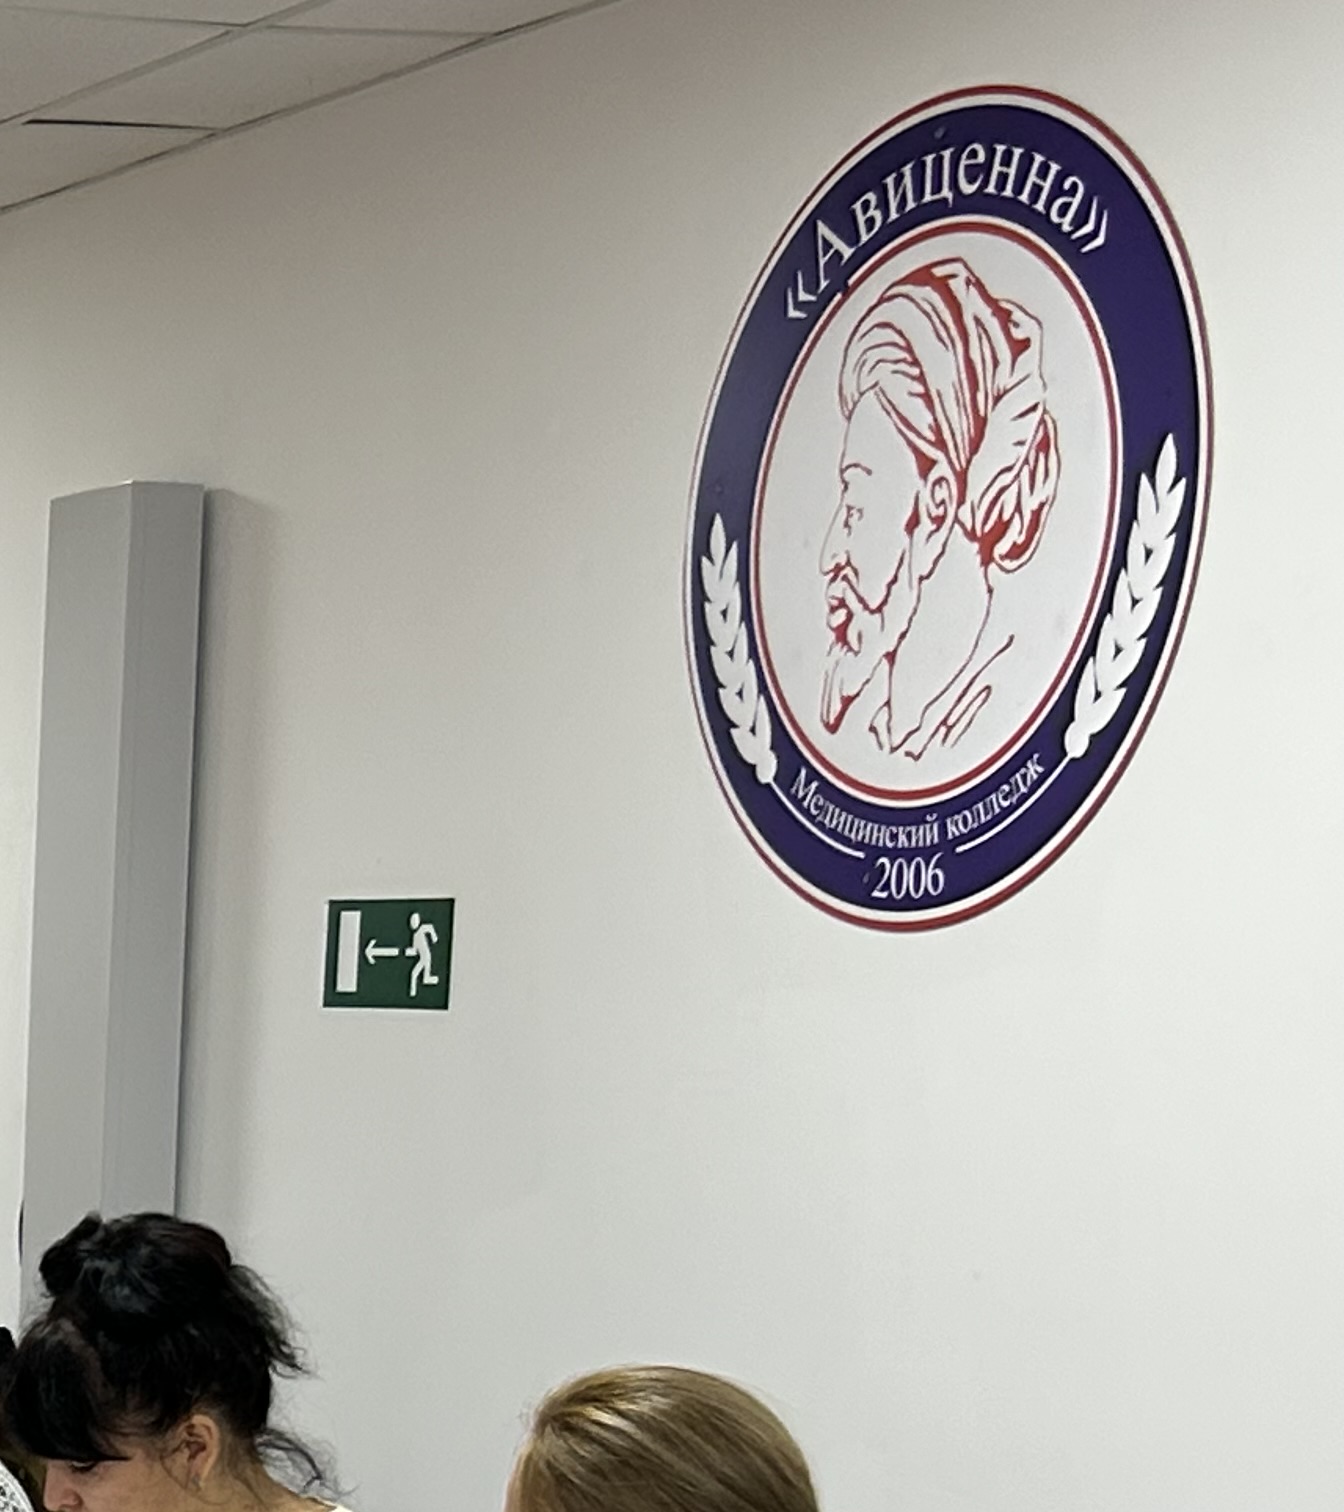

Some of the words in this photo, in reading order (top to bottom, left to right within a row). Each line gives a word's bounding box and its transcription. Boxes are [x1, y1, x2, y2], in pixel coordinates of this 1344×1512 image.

[786, 142, 1108, 319] «Авиценна»
[790, 766, 939, 848] Медицинский
[945, 753, 1044, 839] колледж
[871, 853, 944, 899] 2006
